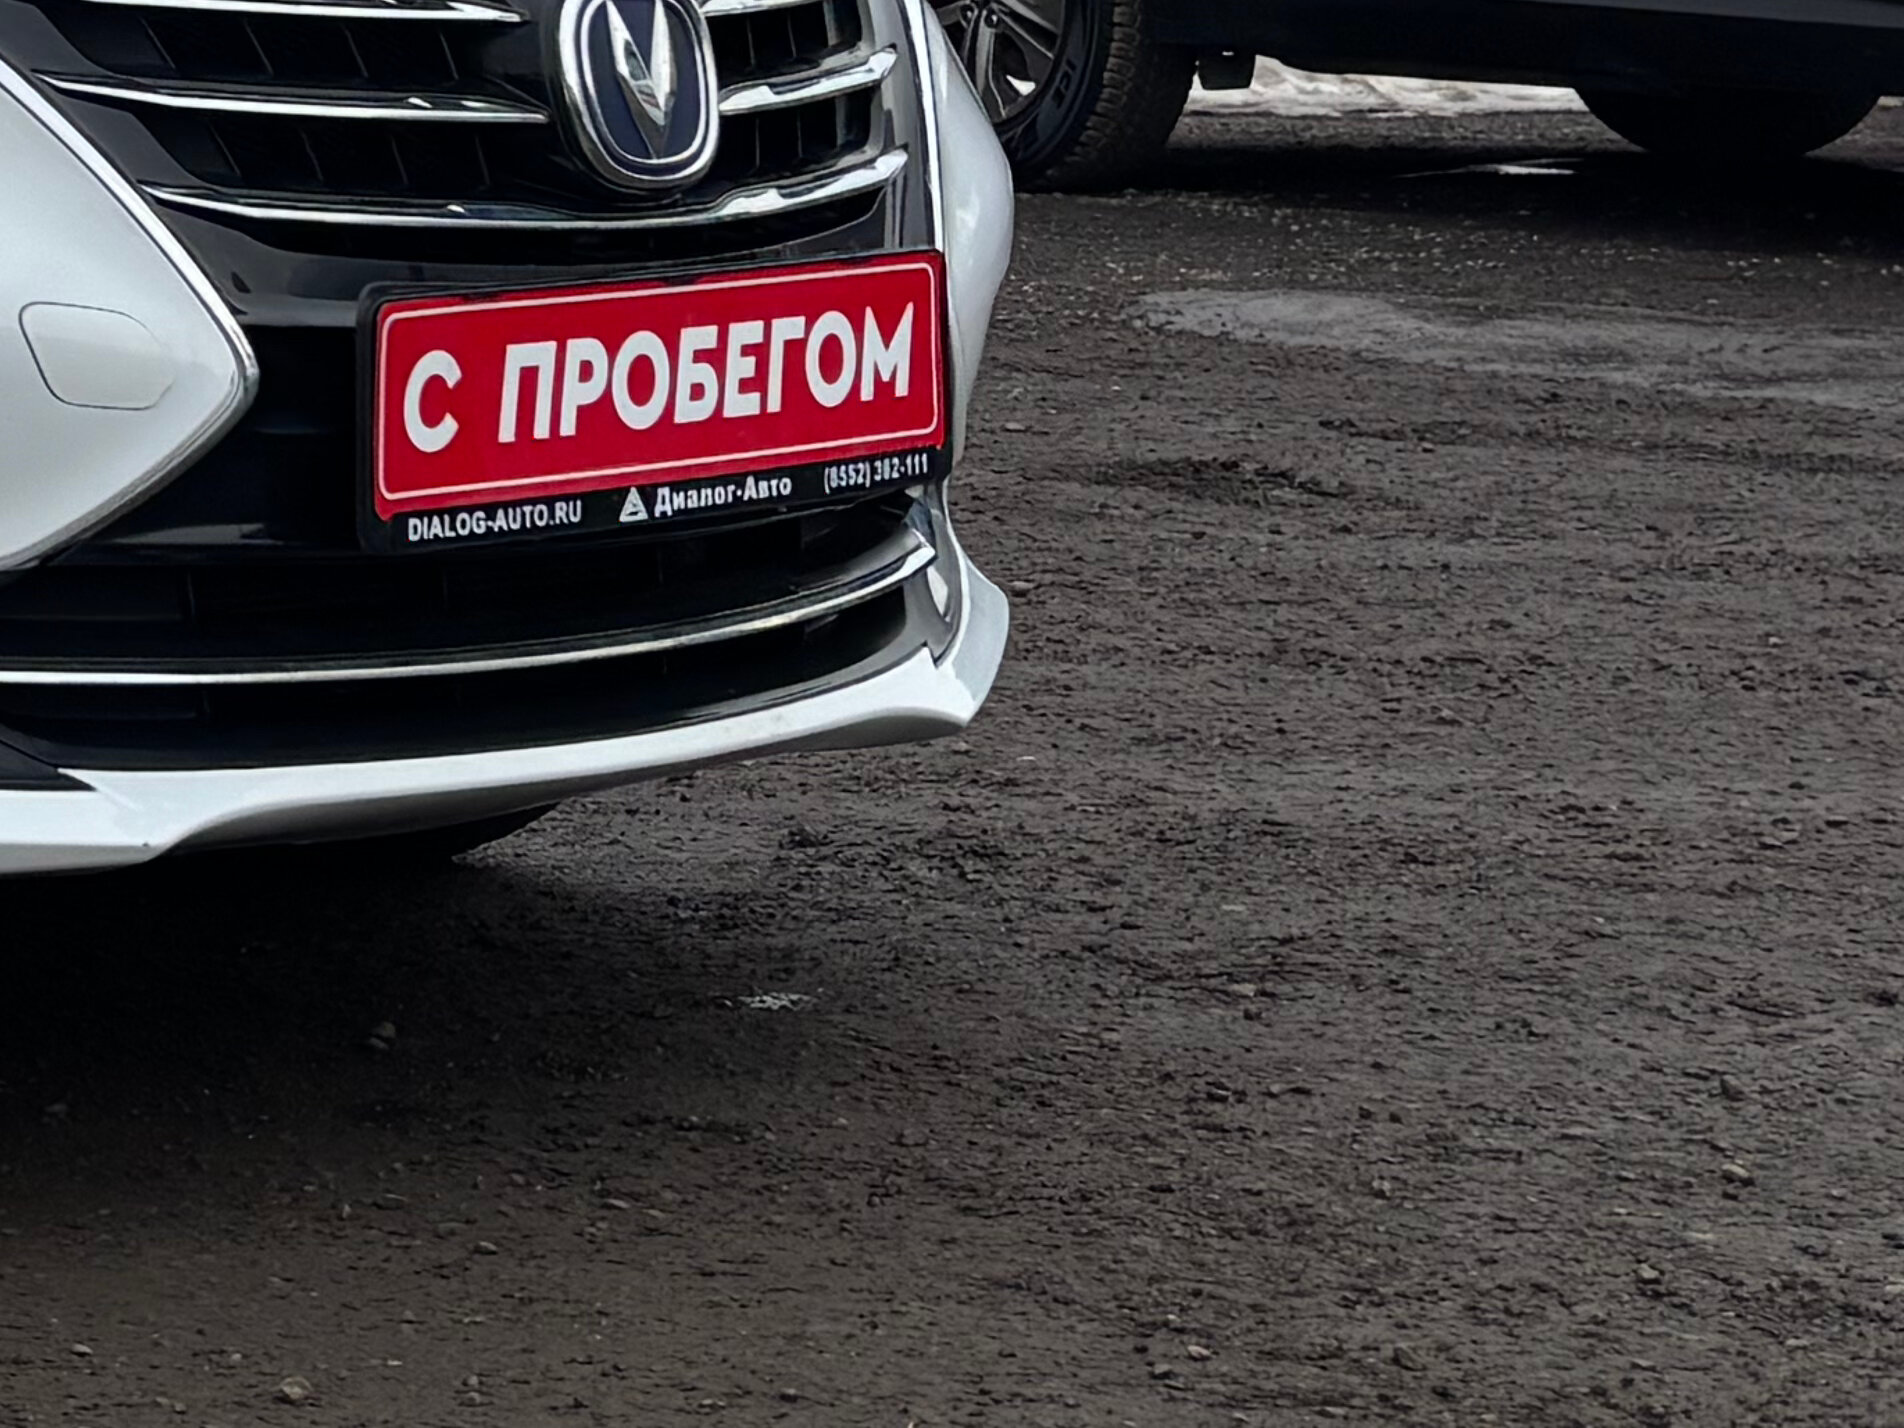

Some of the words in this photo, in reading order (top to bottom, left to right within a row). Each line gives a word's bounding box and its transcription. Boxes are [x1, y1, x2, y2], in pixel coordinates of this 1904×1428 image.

[402, 348, 464, 454] С
[496, 300, 915, 444] ПРОБЕГОМ
[653, 475, 793, 518] Диалог-Авто
[406, 499, 583, 543] DIALOG-AUTO.RU
